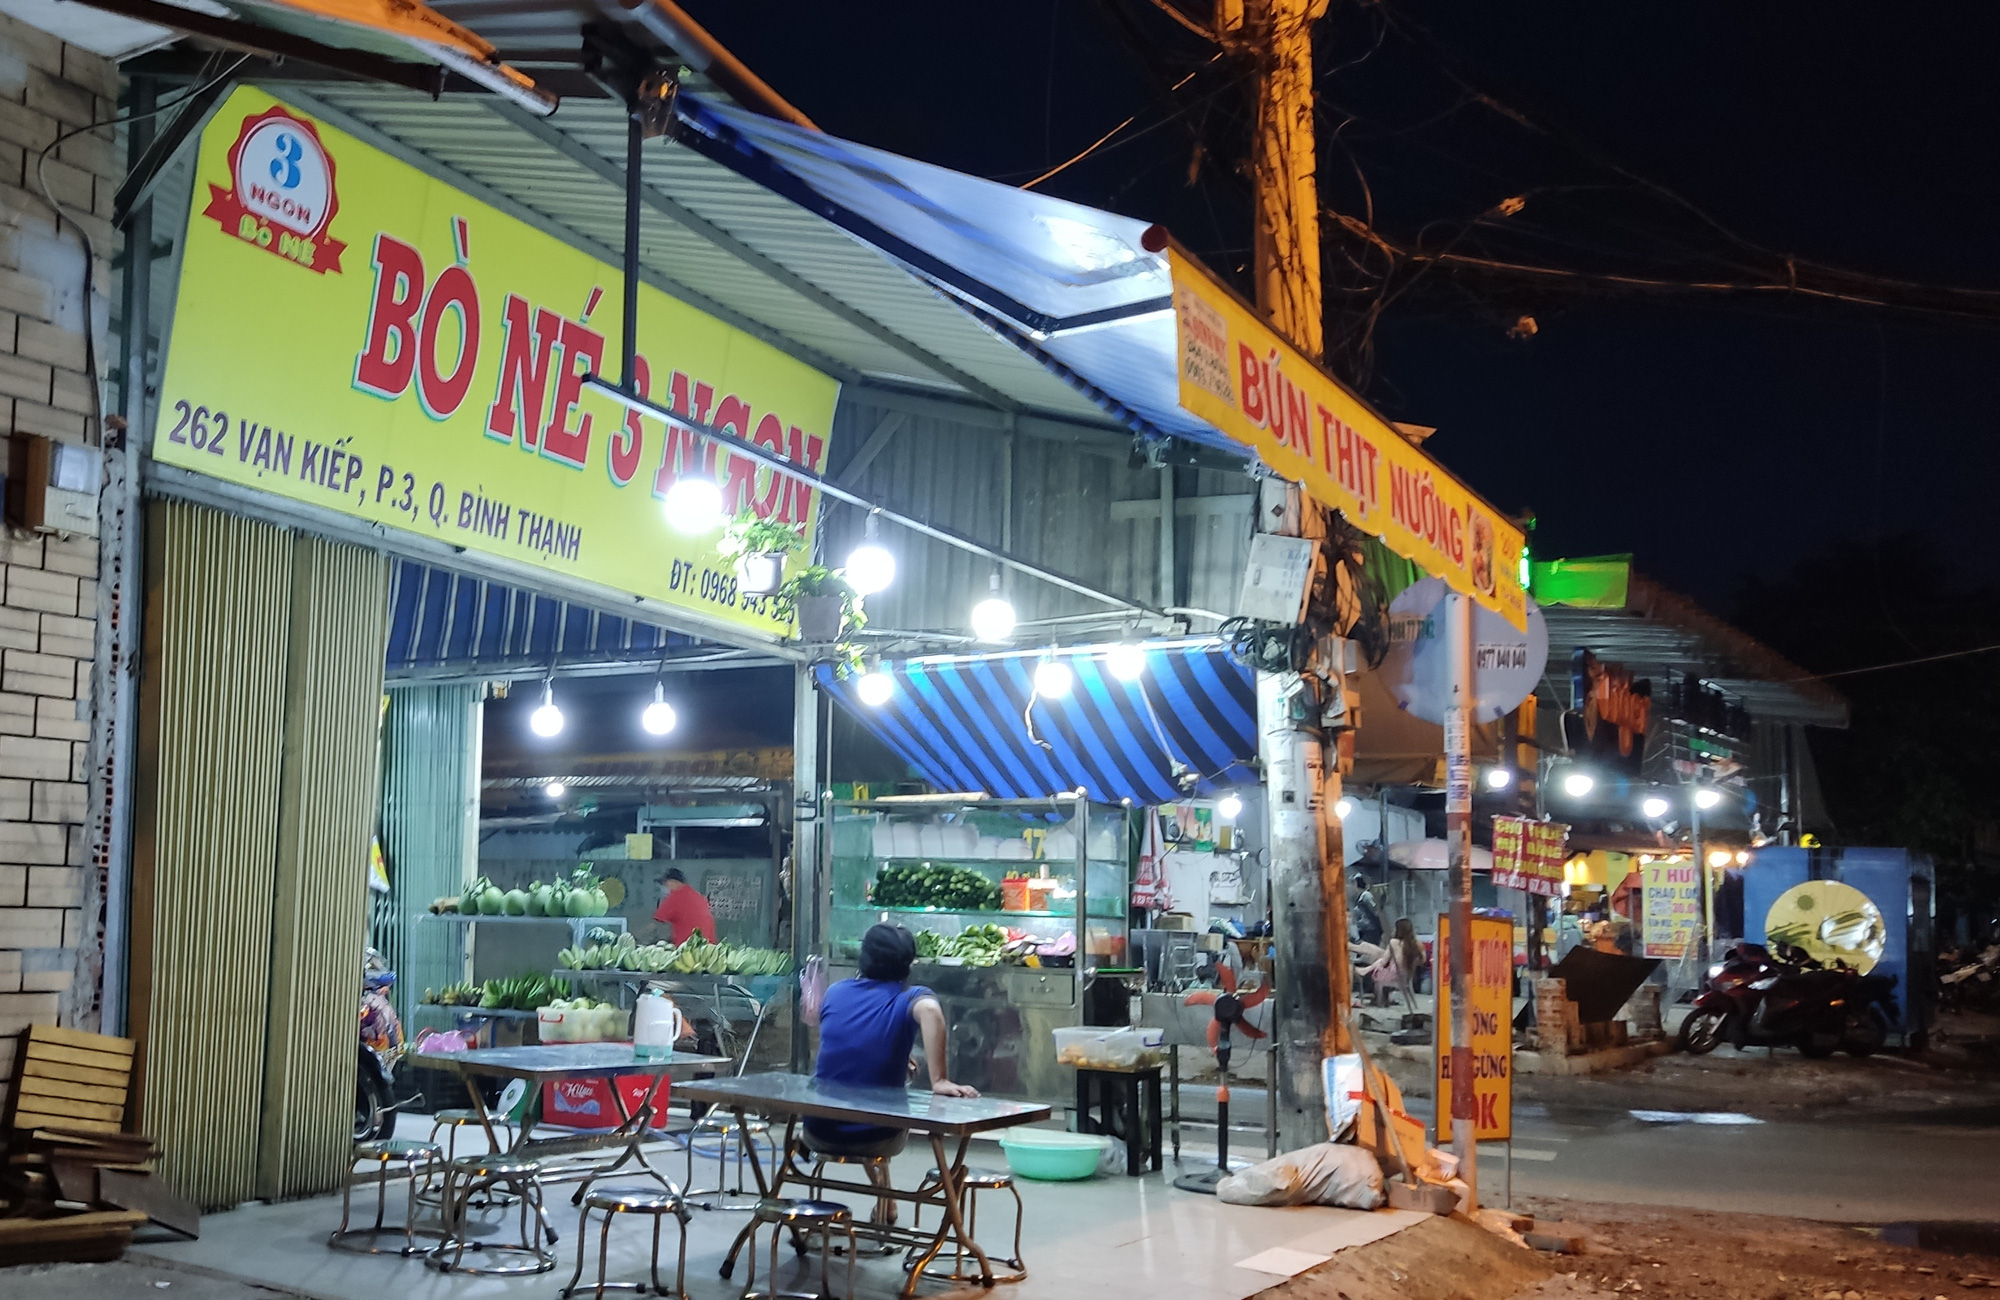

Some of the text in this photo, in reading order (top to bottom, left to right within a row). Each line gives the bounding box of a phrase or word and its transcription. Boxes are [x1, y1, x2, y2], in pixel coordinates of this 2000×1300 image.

[270, 132, 304, 190] 3
[250, 182, 312, 224] NGON
[352, 215, 481, 422] BÒ
[484, 285, 605, 472] NÉ
[606, 353, 651, 488] 3
[169, 399, 583, 562] 262 VẠN KIẾP, P.3, Q. BÌNH THẠNH
[1238, 339, 1316, 466] BÚN
[1316, 402, 1381, 521] THỊT
[1389, 458, 1466, 571] NƯỚNG
[669, 558, 697, 596] ĐT:
[700, 567, 738, 608] 0968
[1023, 827, 1047, 860] 17
